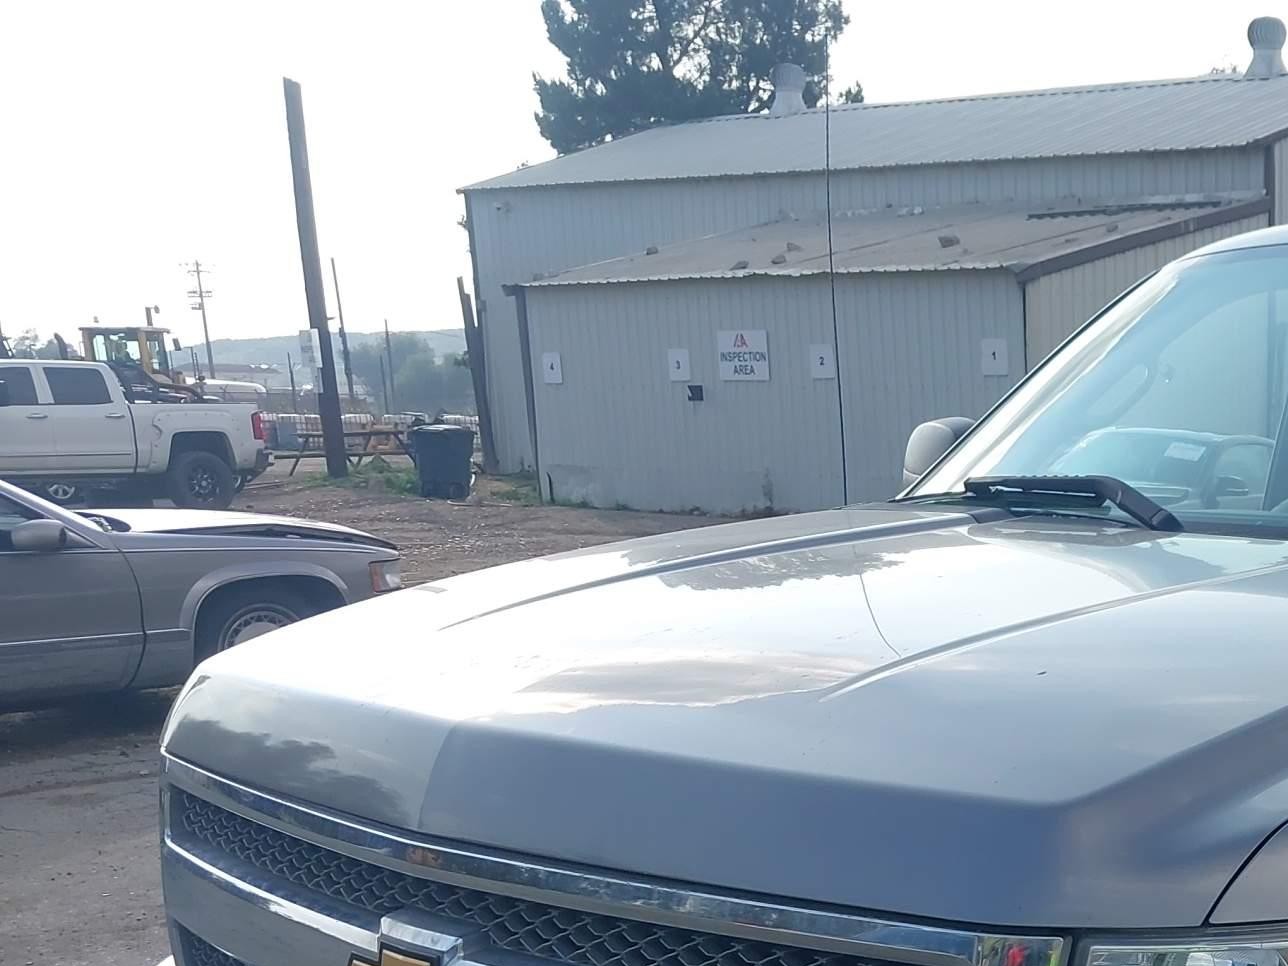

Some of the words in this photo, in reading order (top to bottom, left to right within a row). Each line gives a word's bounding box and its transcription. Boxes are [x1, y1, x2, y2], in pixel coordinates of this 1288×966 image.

[720, 351, 767, 362] INSPECTION
[818, 356, 825, 366] 2
[733, 364, 756, 375] AREA
